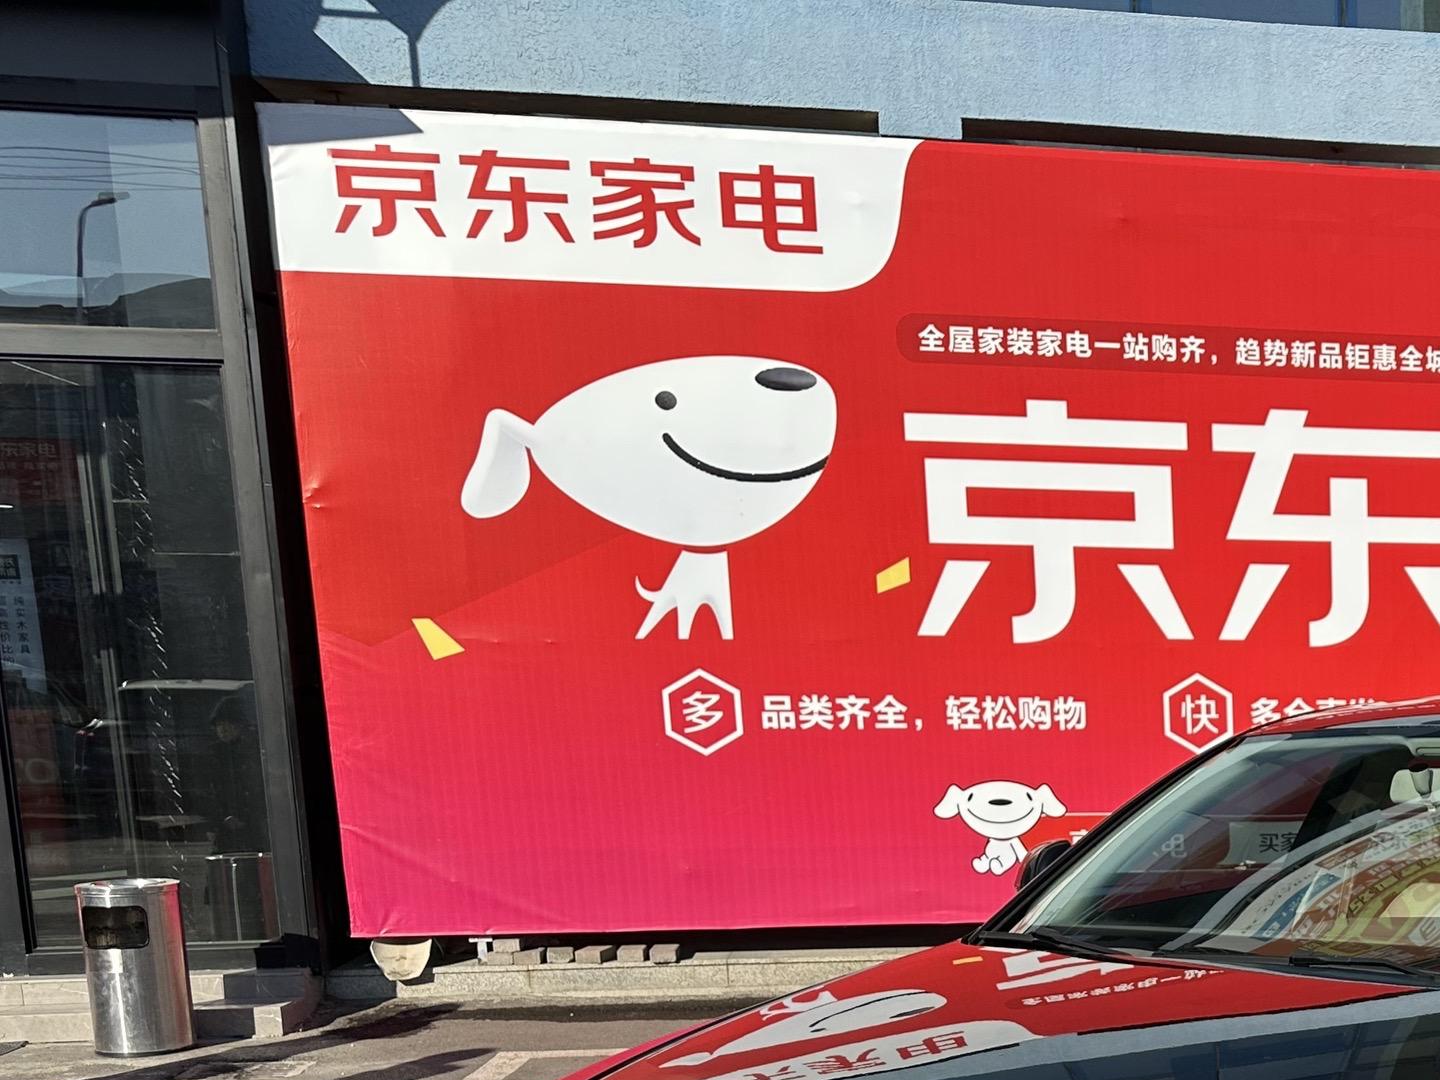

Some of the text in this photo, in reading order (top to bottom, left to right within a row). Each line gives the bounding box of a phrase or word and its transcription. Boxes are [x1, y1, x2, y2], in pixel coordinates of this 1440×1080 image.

[327, 144, 824, 255] 京东家电
[682, 690, 1087, 735] 多 品类齐全，轻松购物
[1181, 693, 1220, 735] 快
